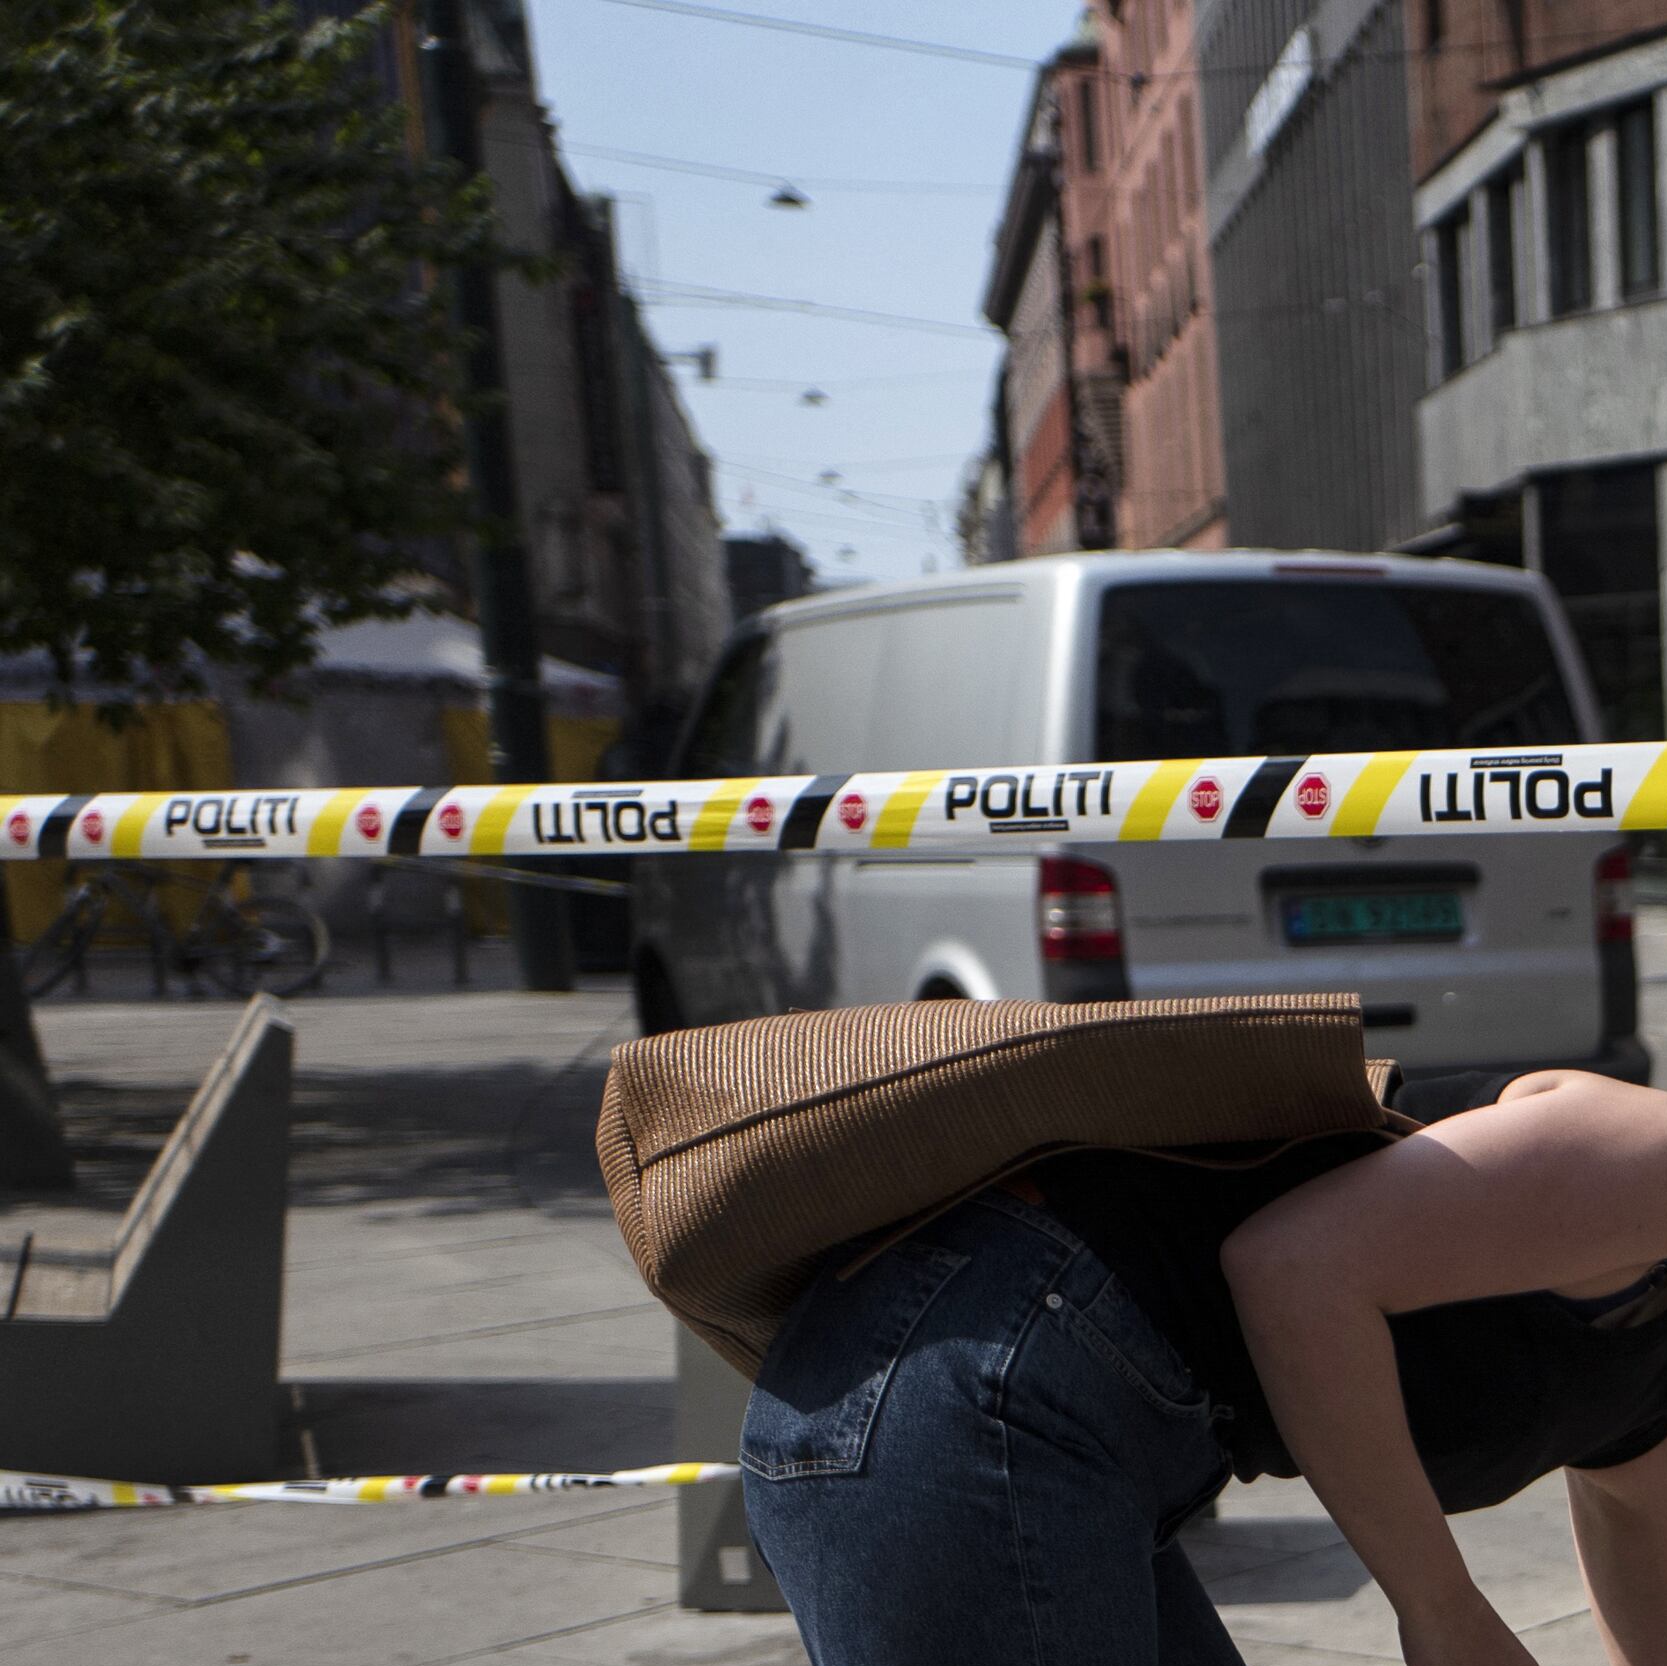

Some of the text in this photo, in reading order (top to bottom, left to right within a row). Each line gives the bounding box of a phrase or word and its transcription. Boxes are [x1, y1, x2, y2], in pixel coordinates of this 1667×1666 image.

[945, 770, 1114, 820] POLITI
[1190, 787, 1221, 810] STOP
[1419, 767, 1614, 822] POLITI
[165, 797, 299, 839] POLITI
[532, 799, 681, 844] POLITI
